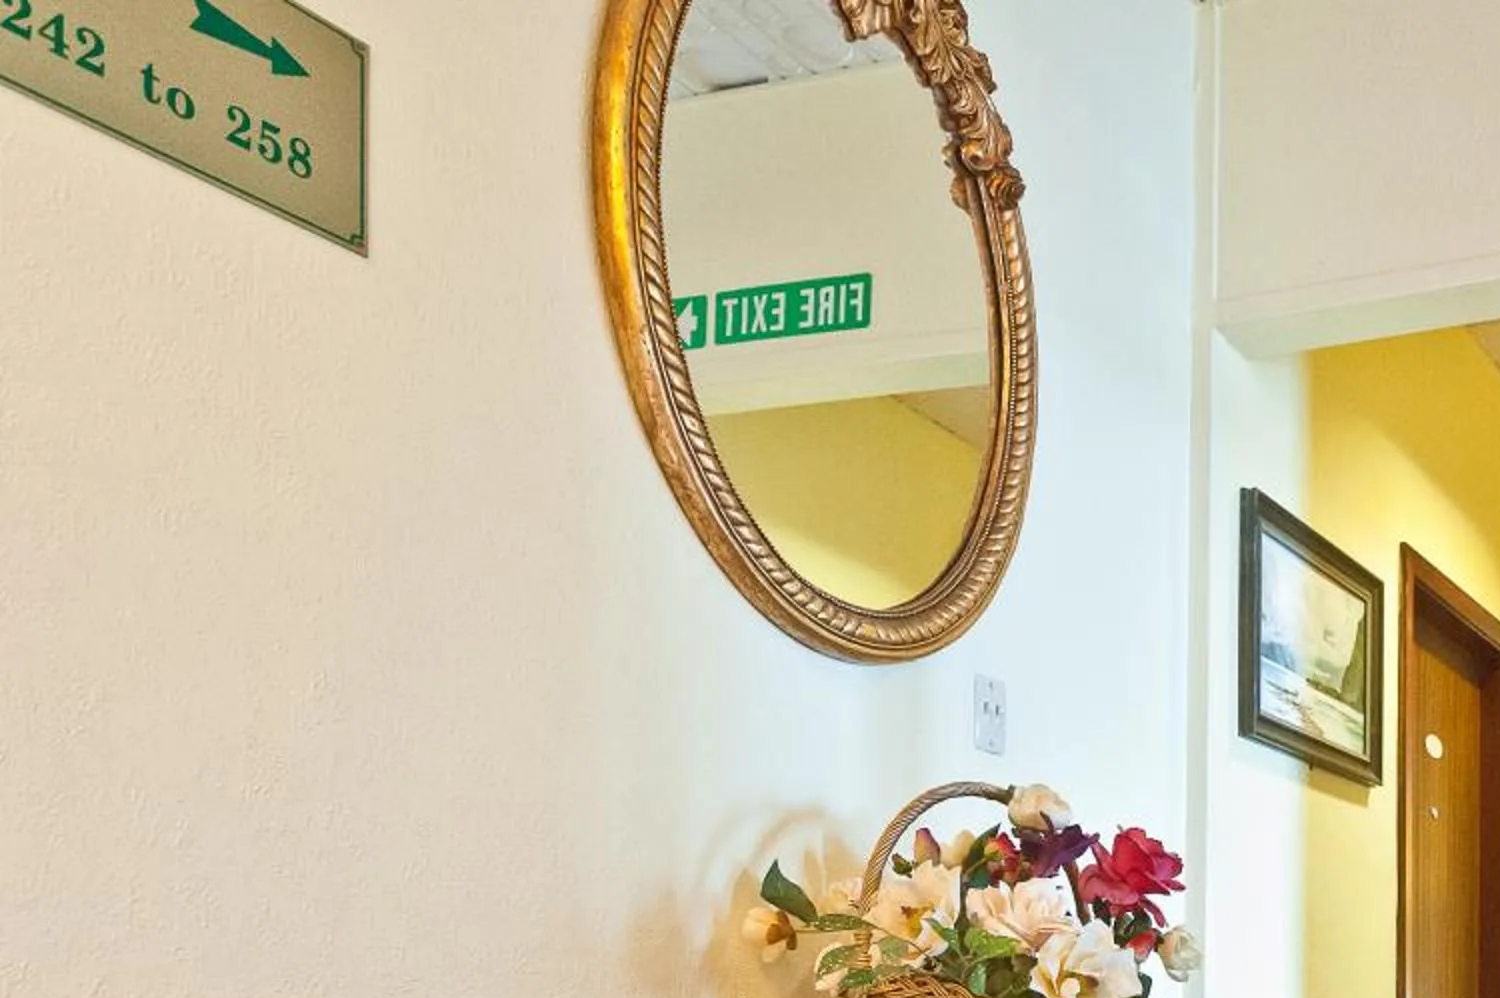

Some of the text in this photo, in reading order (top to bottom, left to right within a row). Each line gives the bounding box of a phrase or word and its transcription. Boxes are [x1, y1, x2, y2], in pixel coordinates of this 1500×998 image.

[0, 0, 313, 179] 242 to 258
